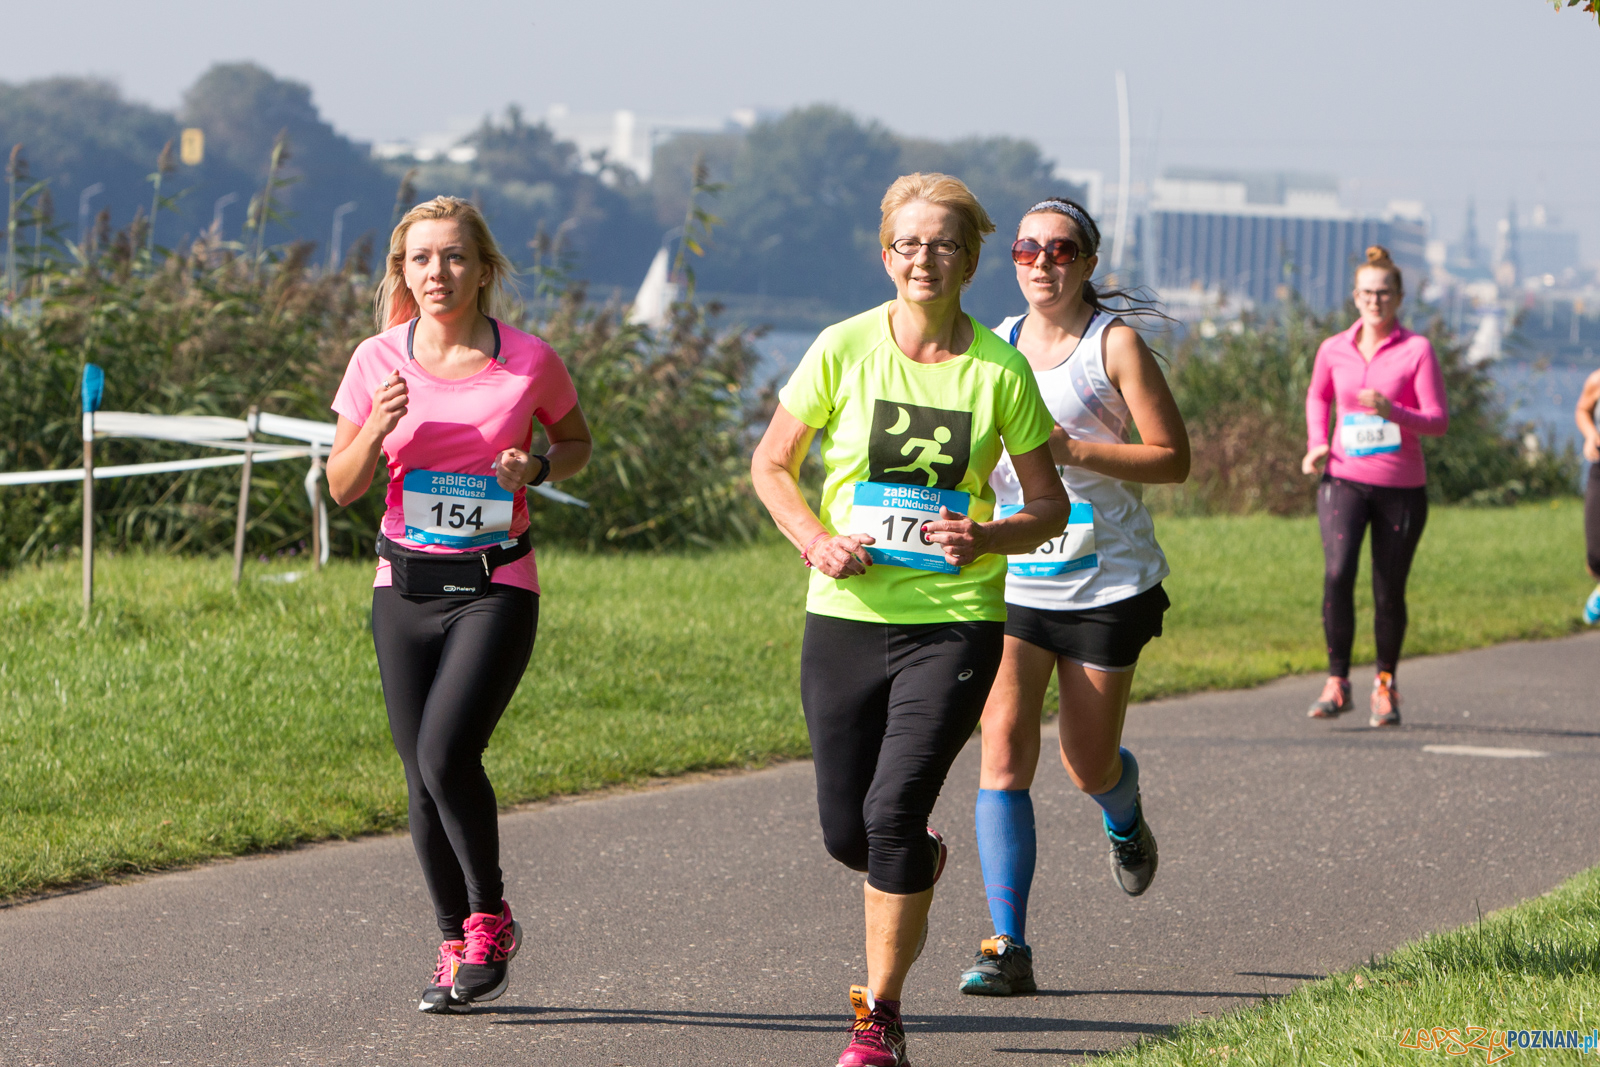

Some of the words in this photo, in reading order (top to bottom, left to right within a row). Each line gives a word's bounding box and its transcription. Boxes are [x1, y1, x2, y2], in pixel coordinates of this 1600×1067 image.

[431, 475, 487, 491] zaBIEGaj
[431, 486, 438, 494] o
[440, 486, 486, 498] FUNdusze
[883, 487, 942, 504] zaBIEGaj
[891, 498, 940, 512] FUNdusze
[431, 502, 484, 531] 154
[1029, 531, 1069, 554] 57
